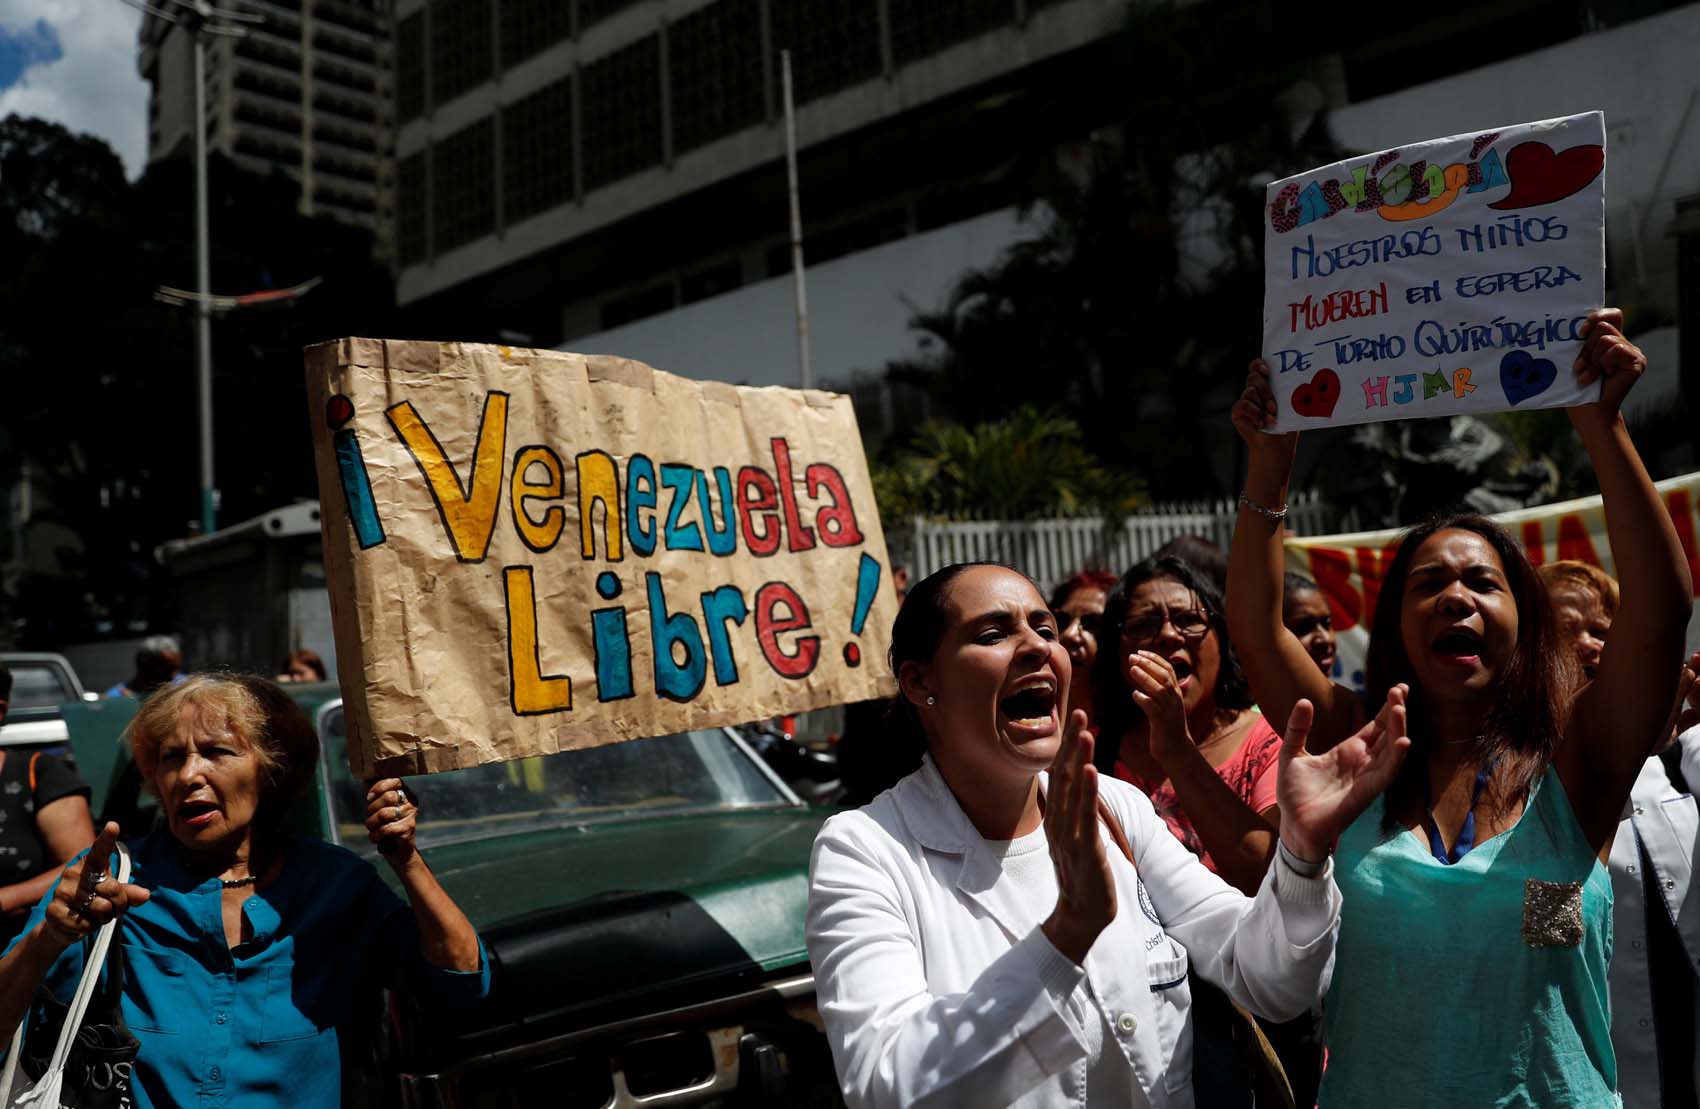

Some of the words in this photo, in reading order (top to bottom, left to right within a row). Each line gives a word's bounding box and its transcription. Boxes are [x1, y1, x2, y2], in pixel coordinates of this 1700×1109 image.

[1291, 226, 1441, 280] NUESTROS
[1457, 214, 1568, 253] NIÑOS
[1288, 281, 1389, 333] MUEREN
[1405, 279, 1442, 304] EN
[1456, 265, 1583, 299] ESPERA
[1273, 349, 1314, 374] DE
[1315, 334, 1406, 365] TURNO
[1361, 363, 1479, 410] HJMR
[502, 552, 881, 717] Libre!
